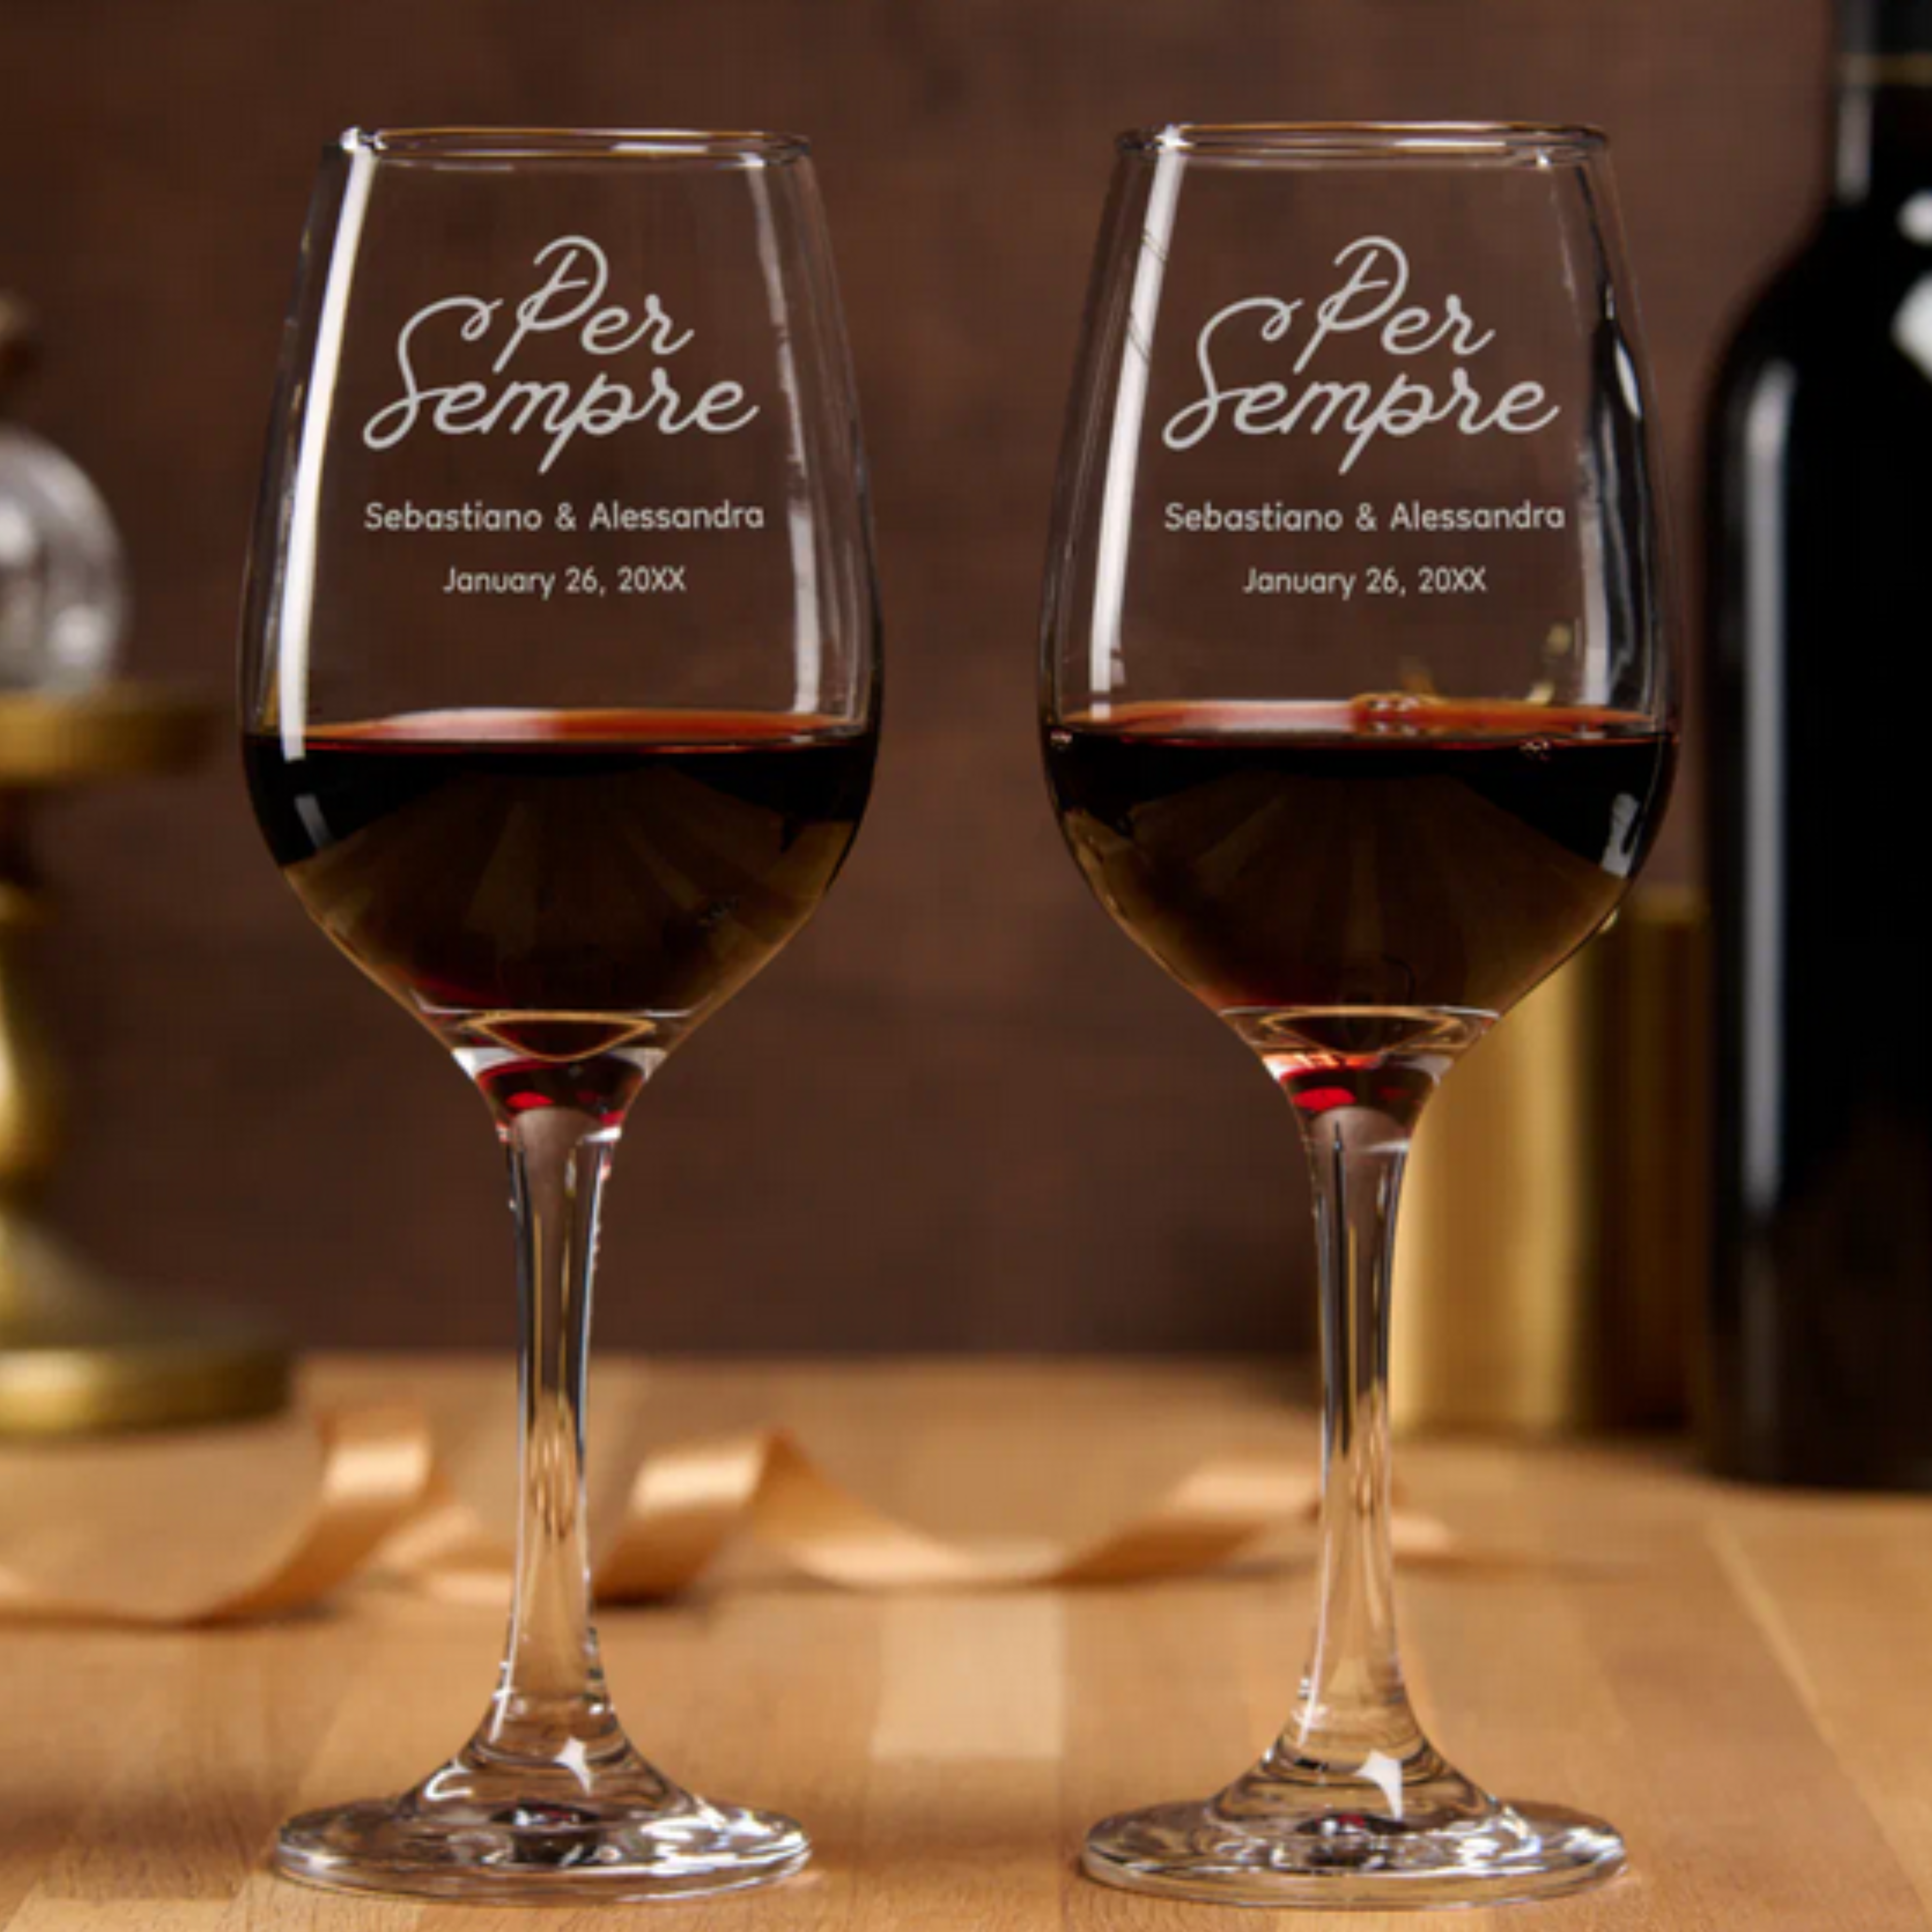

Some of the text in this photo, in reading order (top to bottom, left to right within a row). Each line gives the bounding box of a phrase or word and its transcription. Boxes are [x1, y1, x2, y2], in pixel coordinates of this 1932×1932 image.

[493, 235, 695, 373] Per
[1293, 235, 1495, 373] Per
[363, 296, 759, 474] Sempre
[1162, 297, 1560, 474] Sempre
[365, 500, 764, 530] Sebastiano & Alessandra
[1164, 501, 1565, 531] Sebastiano & Alessandra
[443, 567, 686, 599] January 26, 20XX
[1243, 567, 1486, 600] January 26, 20XX
